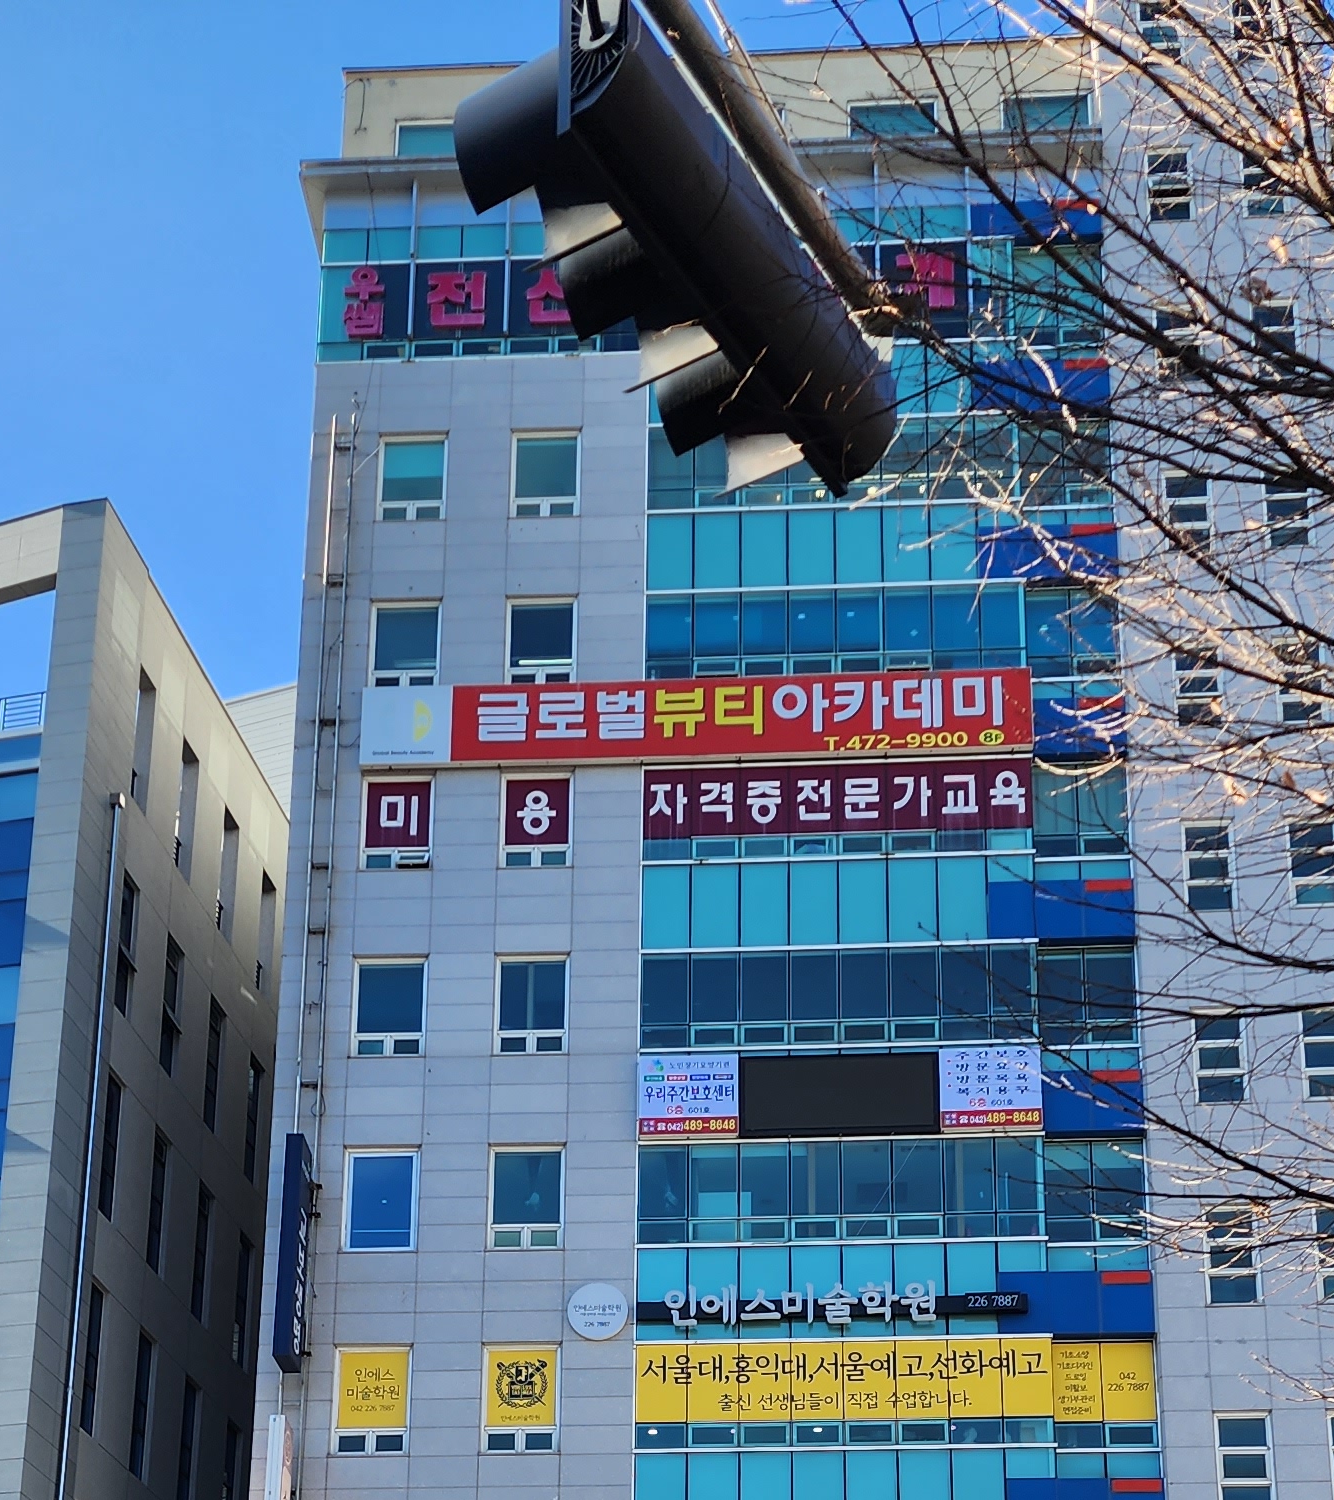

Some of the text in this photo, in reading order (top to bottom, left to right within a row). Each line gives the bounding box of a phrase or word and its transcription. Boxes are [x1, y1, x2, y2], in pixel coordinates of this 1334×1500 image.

[477, 675, 1003, 743] 글로벌뷰티아카데미
[823, 731, 1003, 752] T.472-9900 8F
[649, 770, 1025, 826] 자격증전문가교육
[379, 790, 557, 836] 미 용
[644, 1084, 735, 1103] 우리주간보호센터
[665, 1279, 1019, 1327] 인에스미술학원 226 7887
[354, 1367, 395, 1383] 인에스
[1119, 1372, 1136, 1380] 042
[346, 1386, 400, 1400] 미술학원
[1108, 1383, 1149, 1392] 226 7887
[350, 1404, 363, 1412] 042
[365, 1404, 377, 1412] 226
[718, 1389, 973, 1412] 출신 선생님들이 직접 수업합니다.
